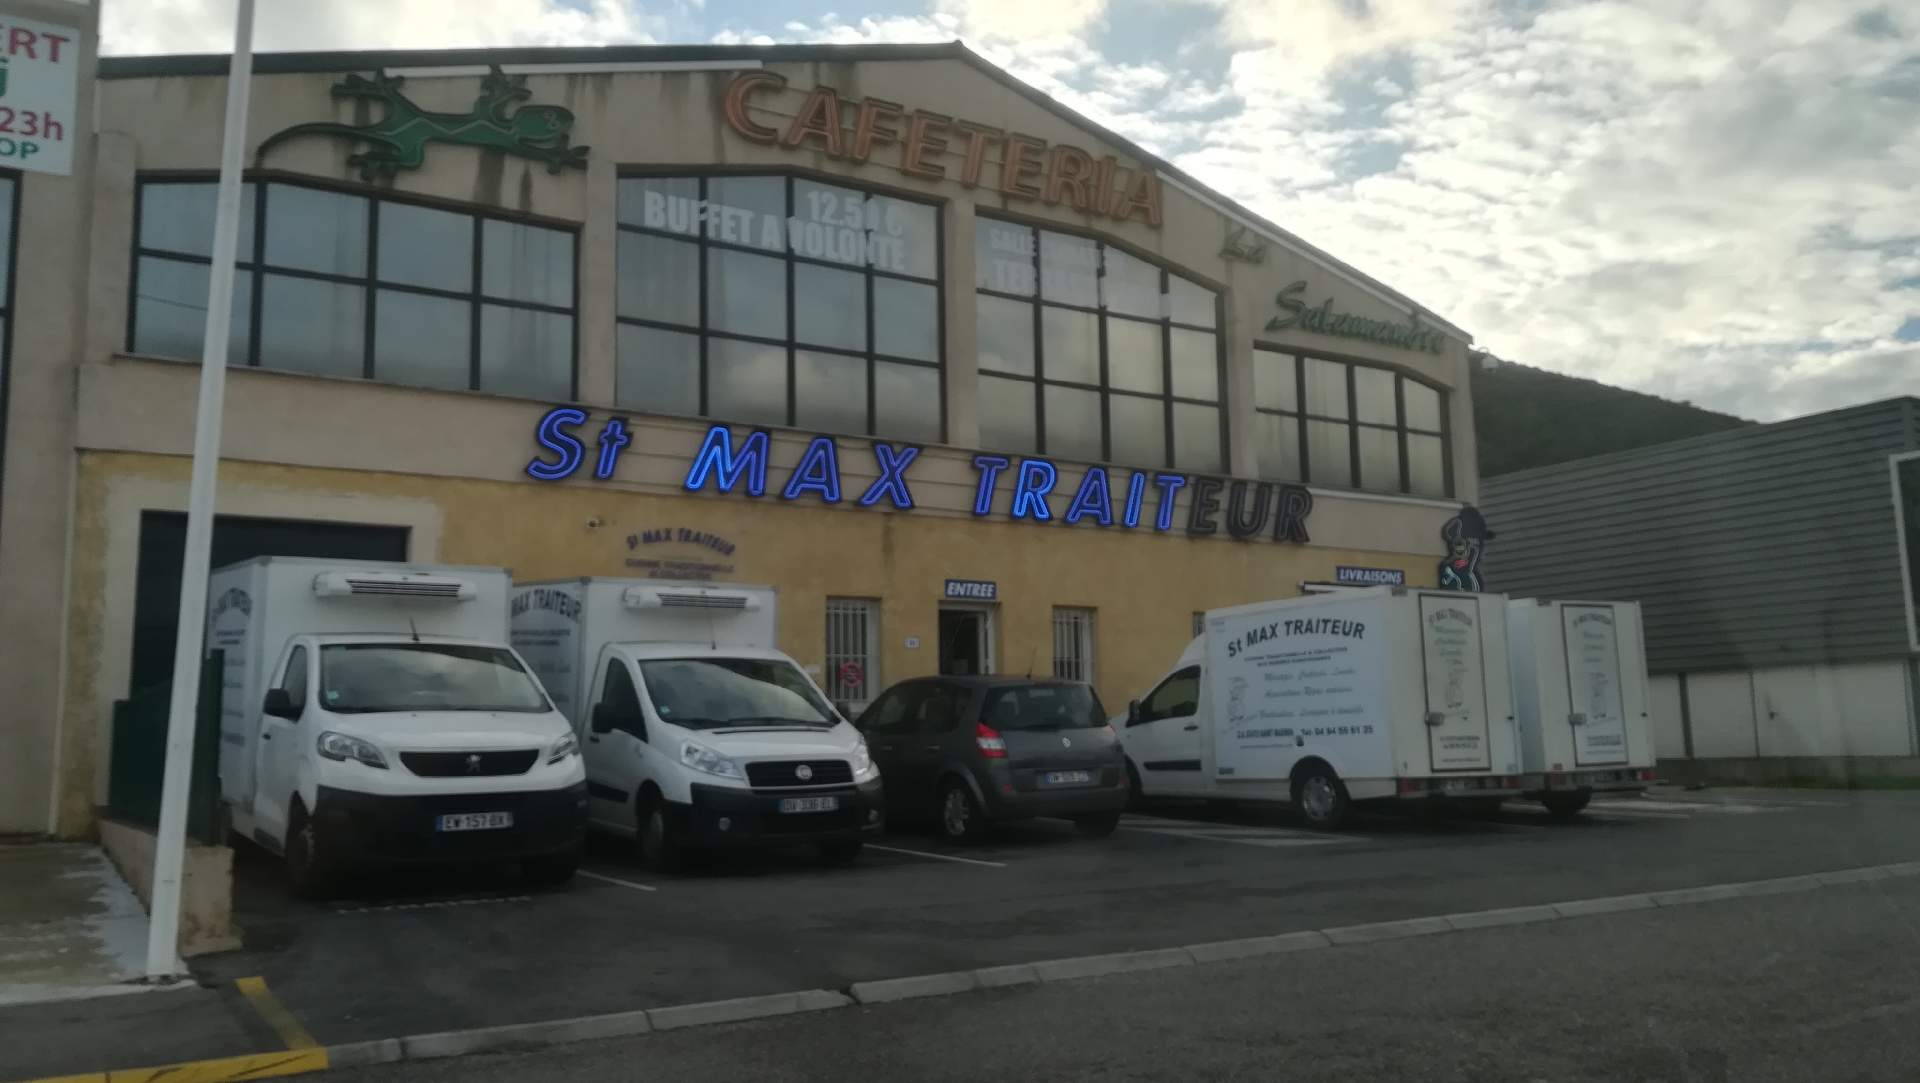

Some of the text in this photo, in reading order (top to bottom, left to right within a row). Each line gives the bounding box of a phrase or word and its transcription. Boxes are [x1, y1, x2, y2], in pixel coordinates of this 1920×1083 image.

[0, 25, 70, 62] RT
[725, 70, 1163, 226] CAFETERIA
[644, 189, 754, 244] BUFFET
[525, 406, 1313, 542] St MAX TRAITEUR
[1340, 568, 1402, 583] LIVRAISONS
[534, 588, 582, 624] TRAITEUR
[1246, 622, 1279, 647] MAX
[1284, 618, 1365, 639] TRAITEUR
